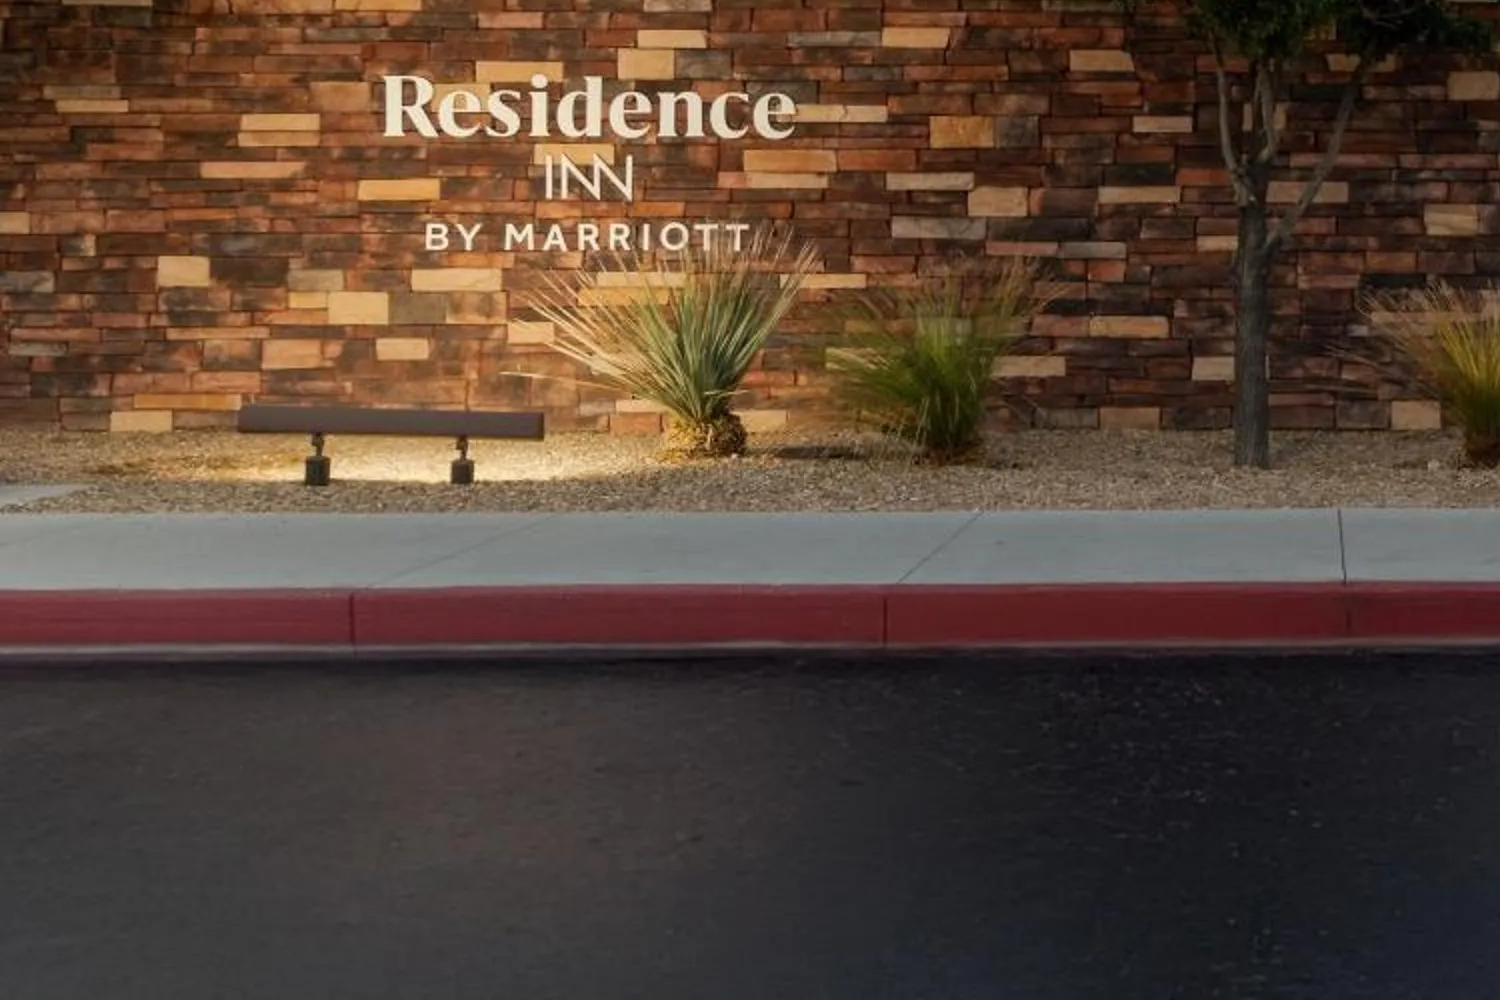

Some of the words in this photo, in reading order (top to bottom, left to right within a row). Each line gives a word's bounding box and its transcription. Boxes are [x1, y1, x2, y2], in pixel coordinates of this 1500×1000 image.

[383, 73, 796, 139] Residence
[545, 153, 633, 200] INN
[425, 223, 482, 251] BY
[504, 222, 749, 251] MARRIOTT
